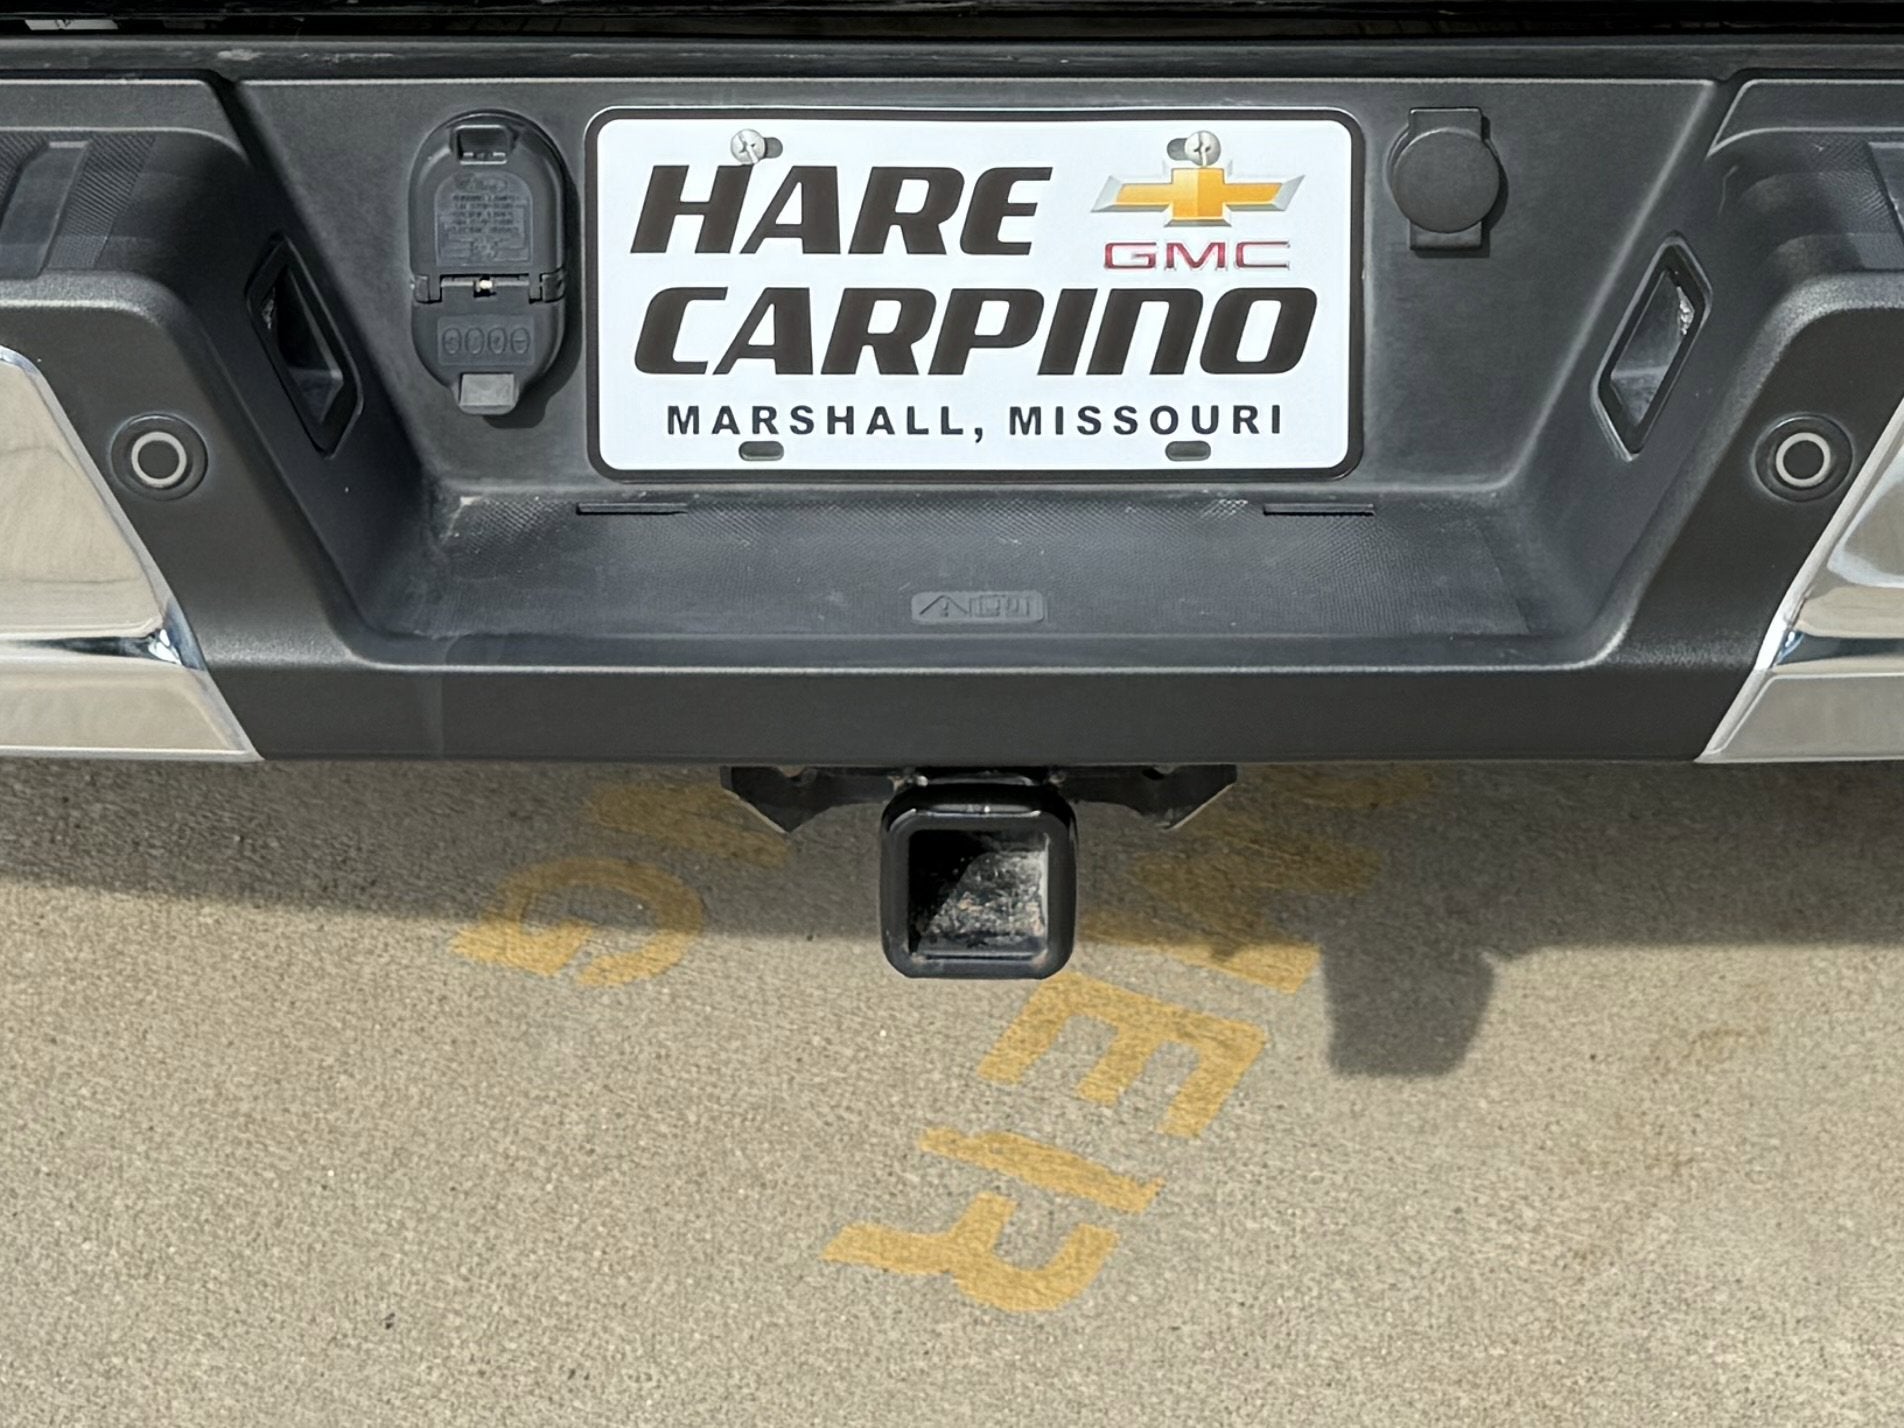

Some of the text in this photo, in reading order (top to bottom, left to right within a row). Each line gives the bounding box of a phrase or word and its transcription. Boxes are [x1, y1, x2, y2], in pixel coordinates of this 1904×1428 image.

[629, 164, 1052, 256] HARE
[1102, 239, 1293, 272] GMC
[633, 286, 1318, 375] CARPINO
[666, 403, 1283, 444] MARSHALL, MISSOURI
